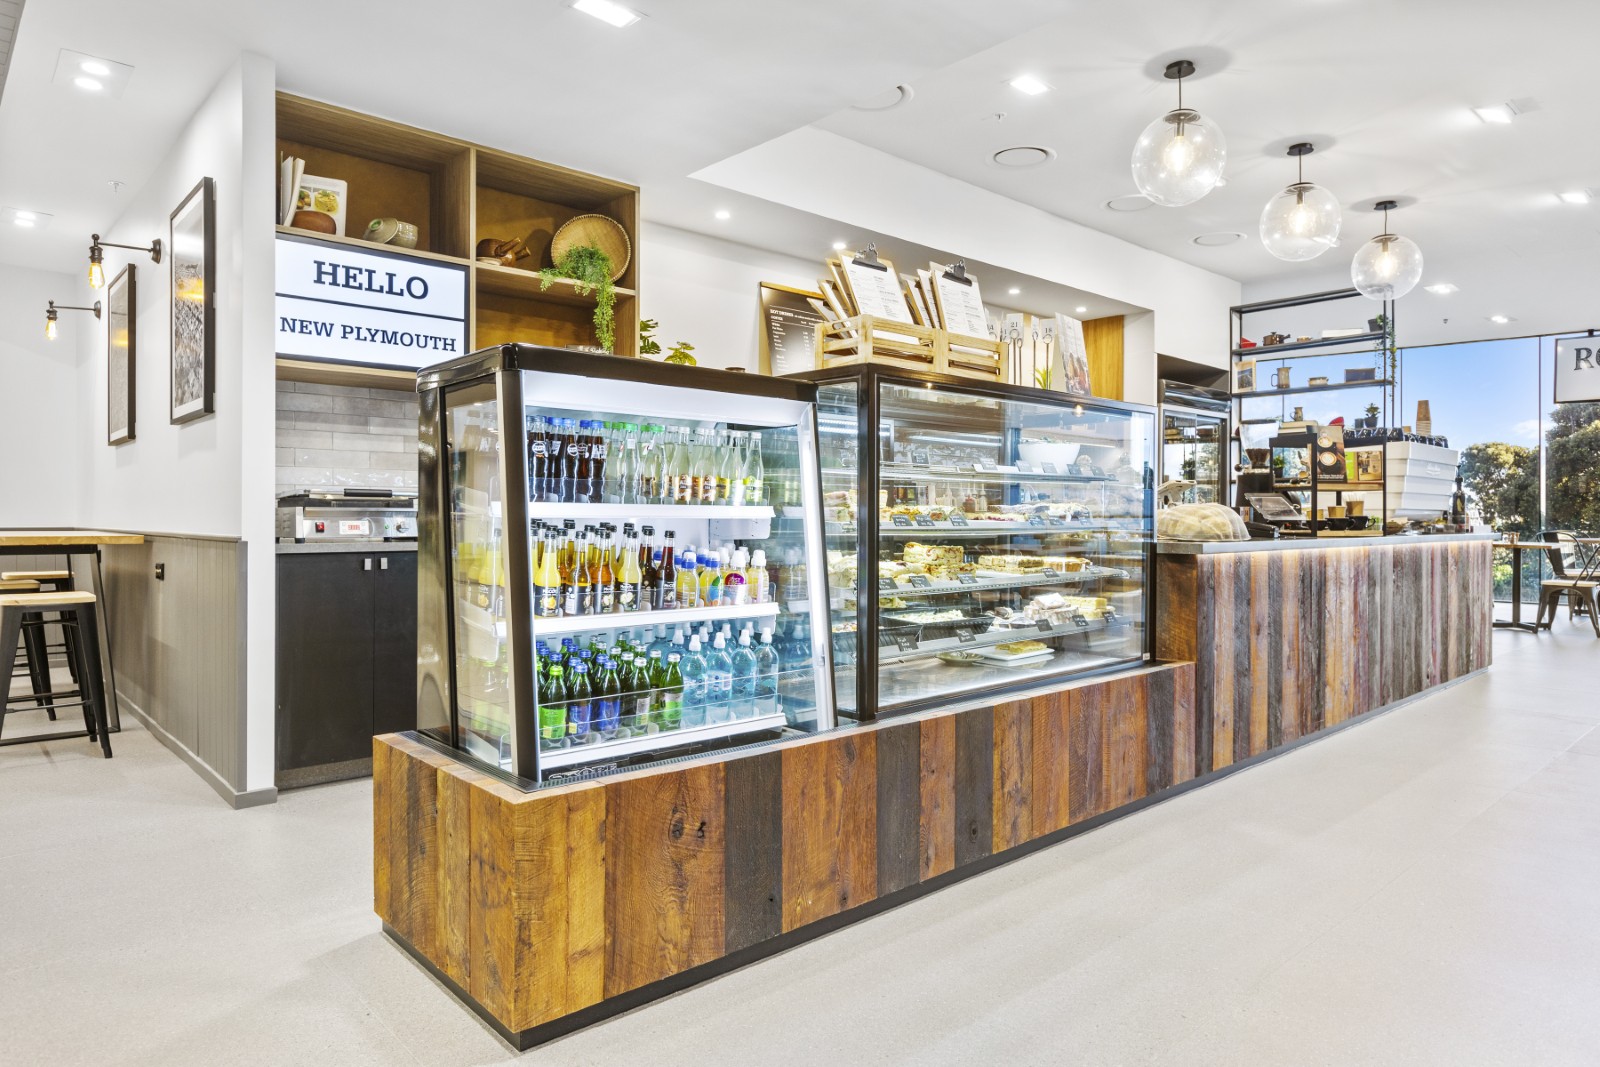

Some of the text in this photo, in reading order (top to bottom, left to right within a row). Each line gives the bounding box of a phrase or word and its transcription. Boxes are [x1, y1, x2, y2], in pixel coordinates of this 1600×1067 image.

[313, 260, 429, 300] HELLO
[279, 316, 457, 352] NEW PLYMOUTH
[1574, 347, 1600, 370] R
